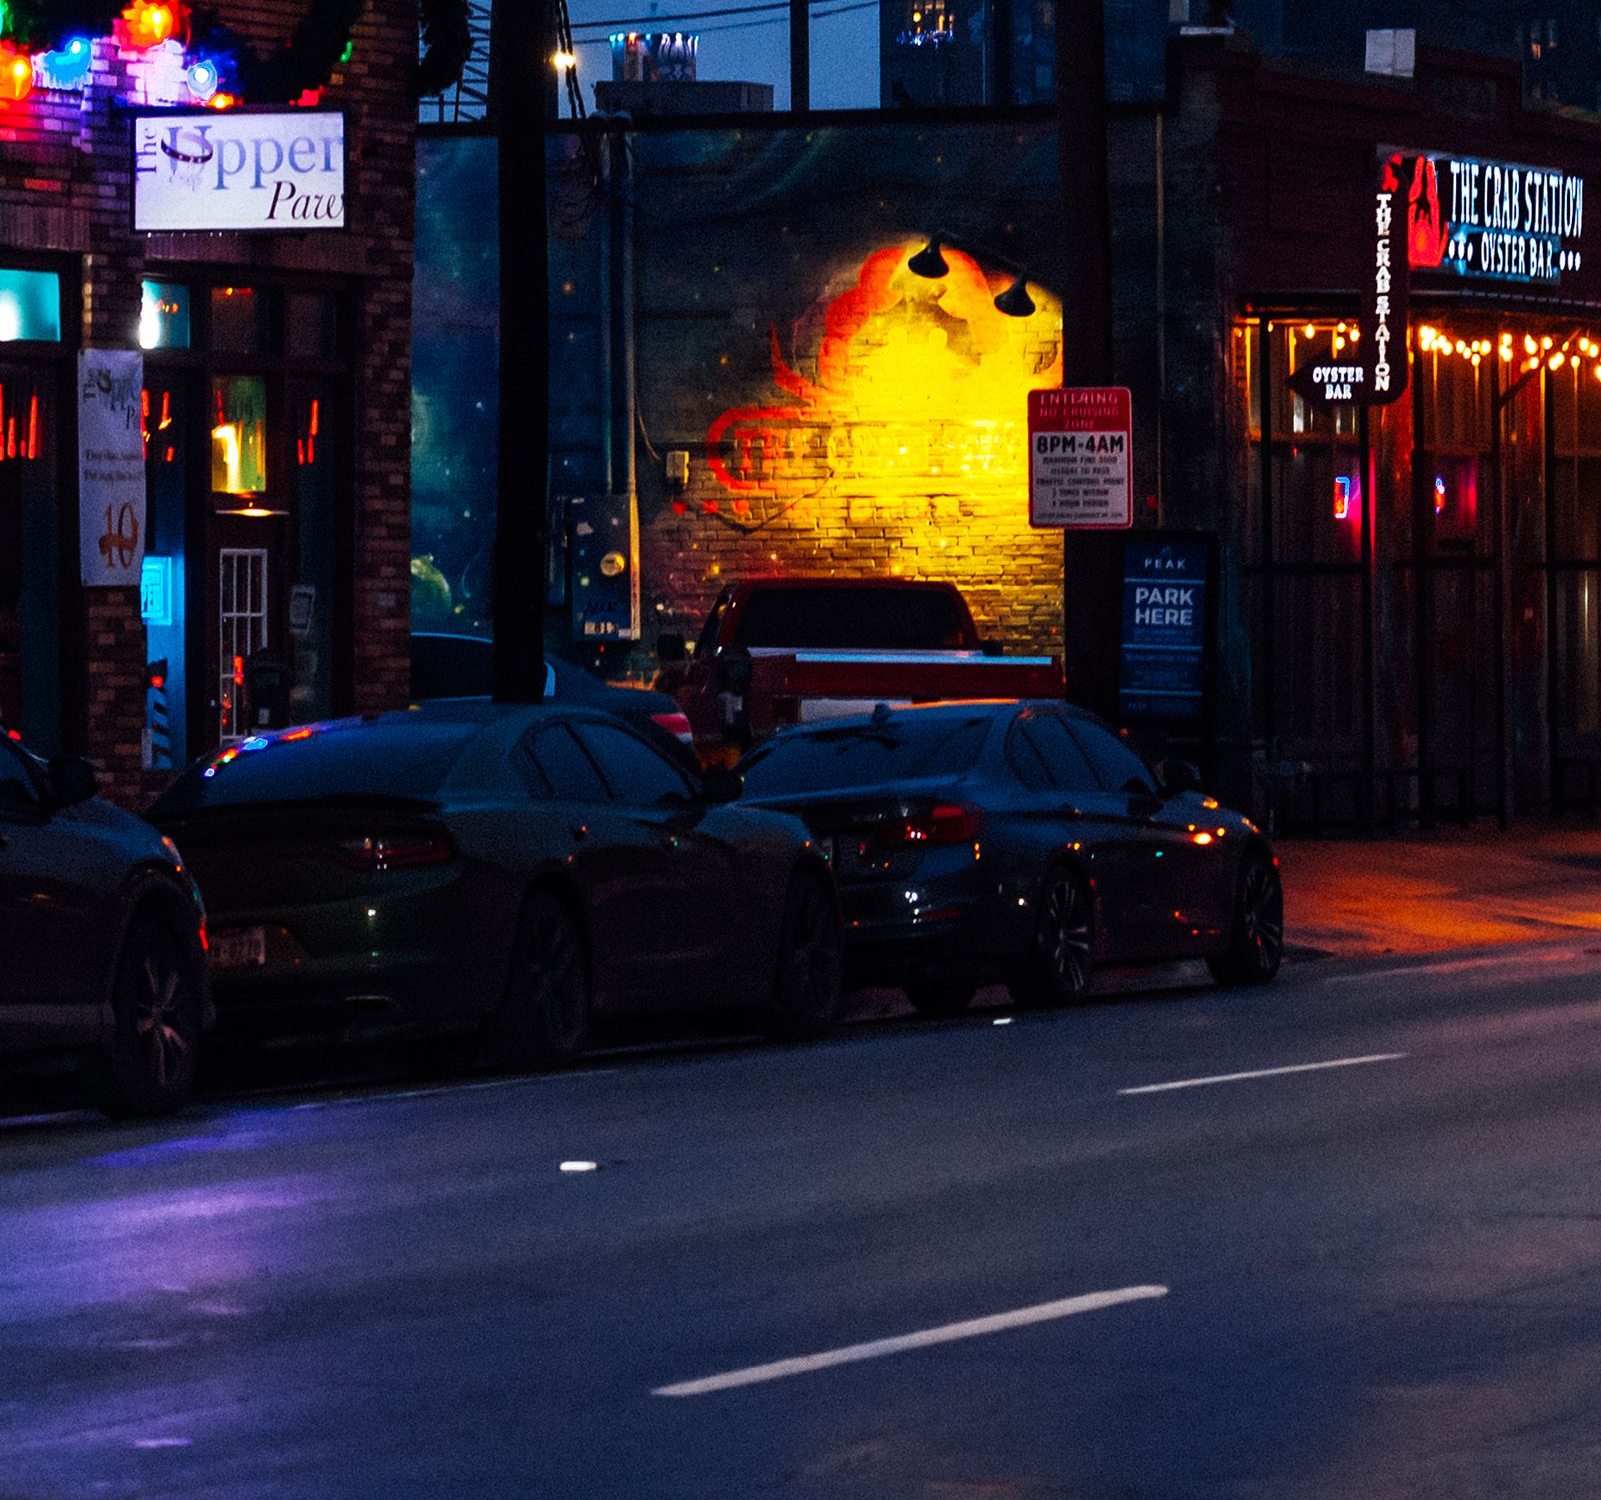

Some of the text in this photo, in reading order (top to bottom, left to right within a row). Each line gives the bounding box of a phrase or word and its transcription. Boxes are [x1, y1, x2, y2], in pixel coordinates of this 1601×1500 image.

[1450, 160, 1584, 239] THE CRAB STATION
[1480, 231, 1553, 279] OYSTER BAR
[1374, 295, 1391, 392] STATION
[1312, 366, 1364, 384] OYSTER
[1040, 391, 1118, 406] ENTERING
[1325, 383, 1352, 400] BAR
[1040, 406, 1057, 417] NO
[1036, 434, 1124, 454] 8PM-4AM
[1144, 557, 1187, 570] PEAK
[1134, 586, 1194, 606] PARK
[1134, 607, 1193, 626] HERE
